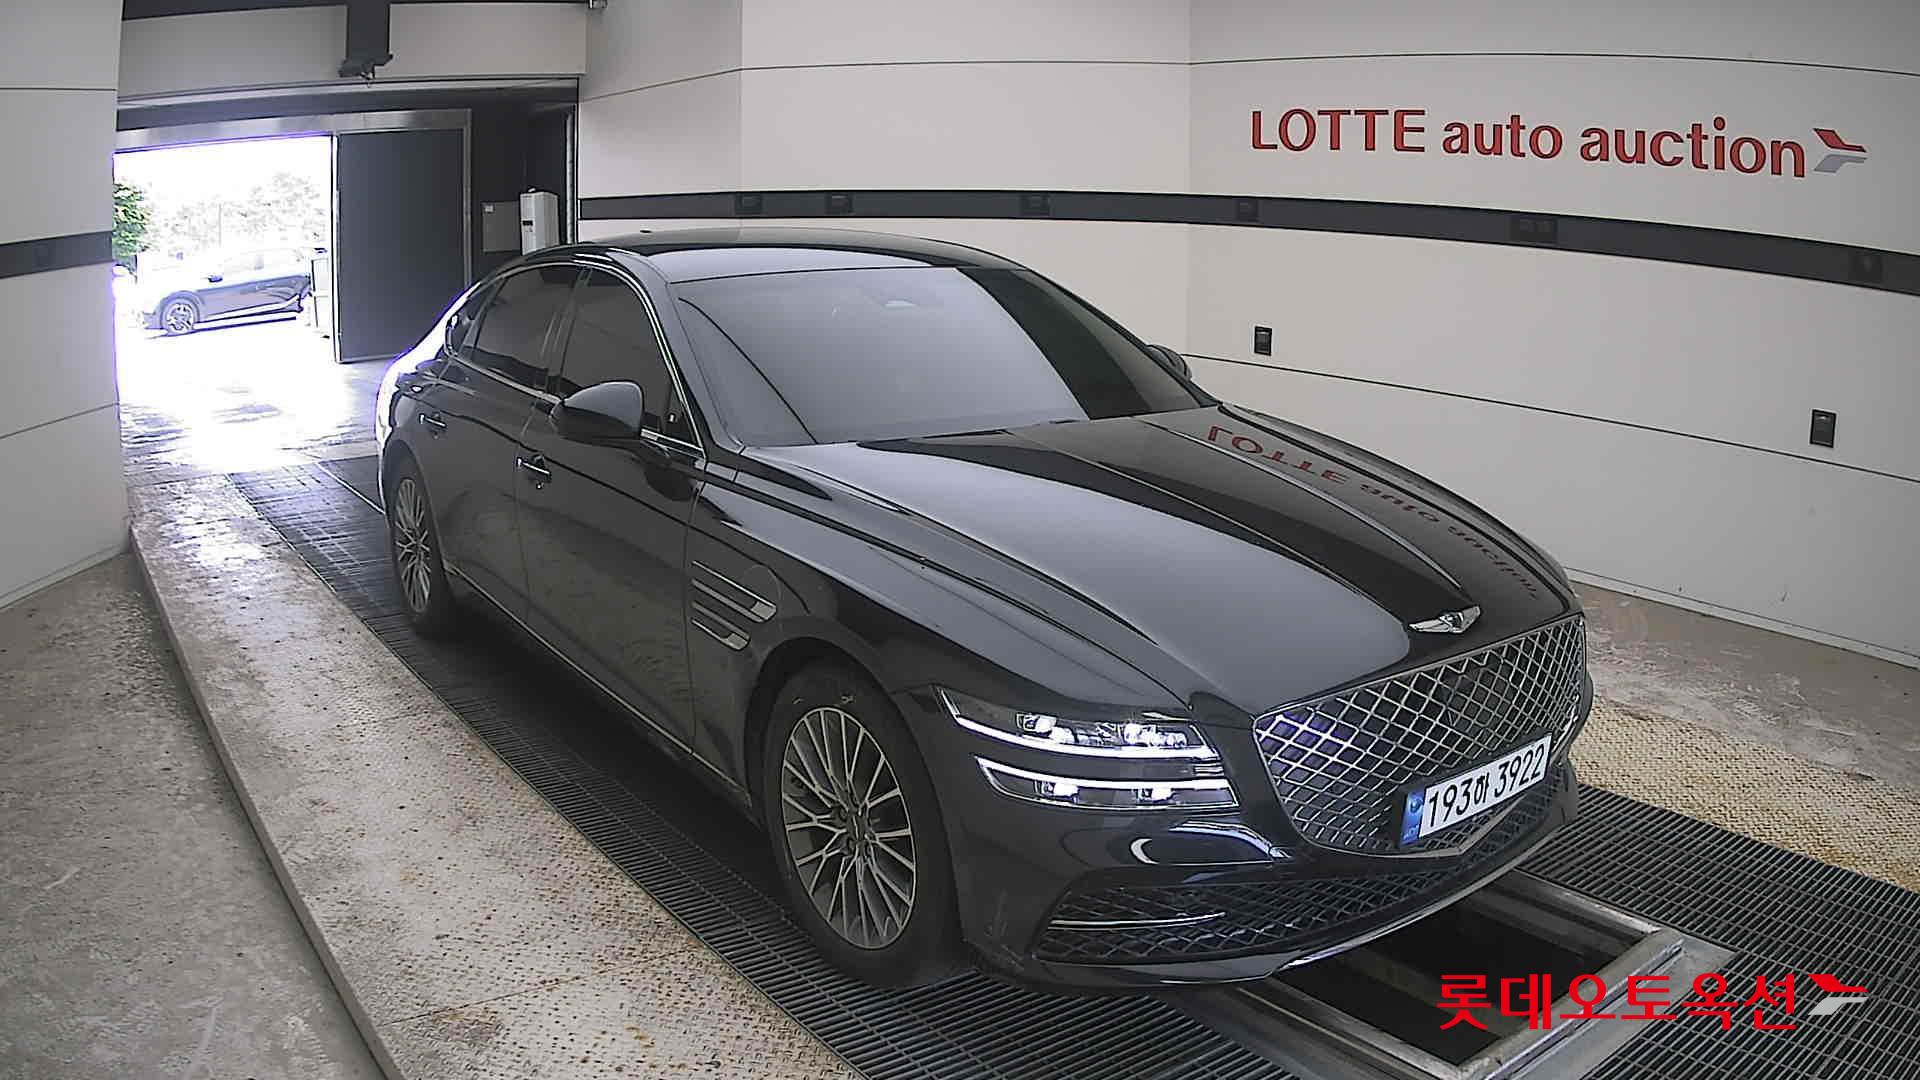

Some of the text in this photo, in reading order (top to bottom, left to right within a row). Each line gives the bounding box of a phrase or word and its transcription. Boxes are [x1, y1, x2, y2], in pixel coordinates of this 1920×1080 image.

[1251, 108, 1806, 178] LOTTE auto auction
[1429, 743, 1546, 828] 193하 3922
